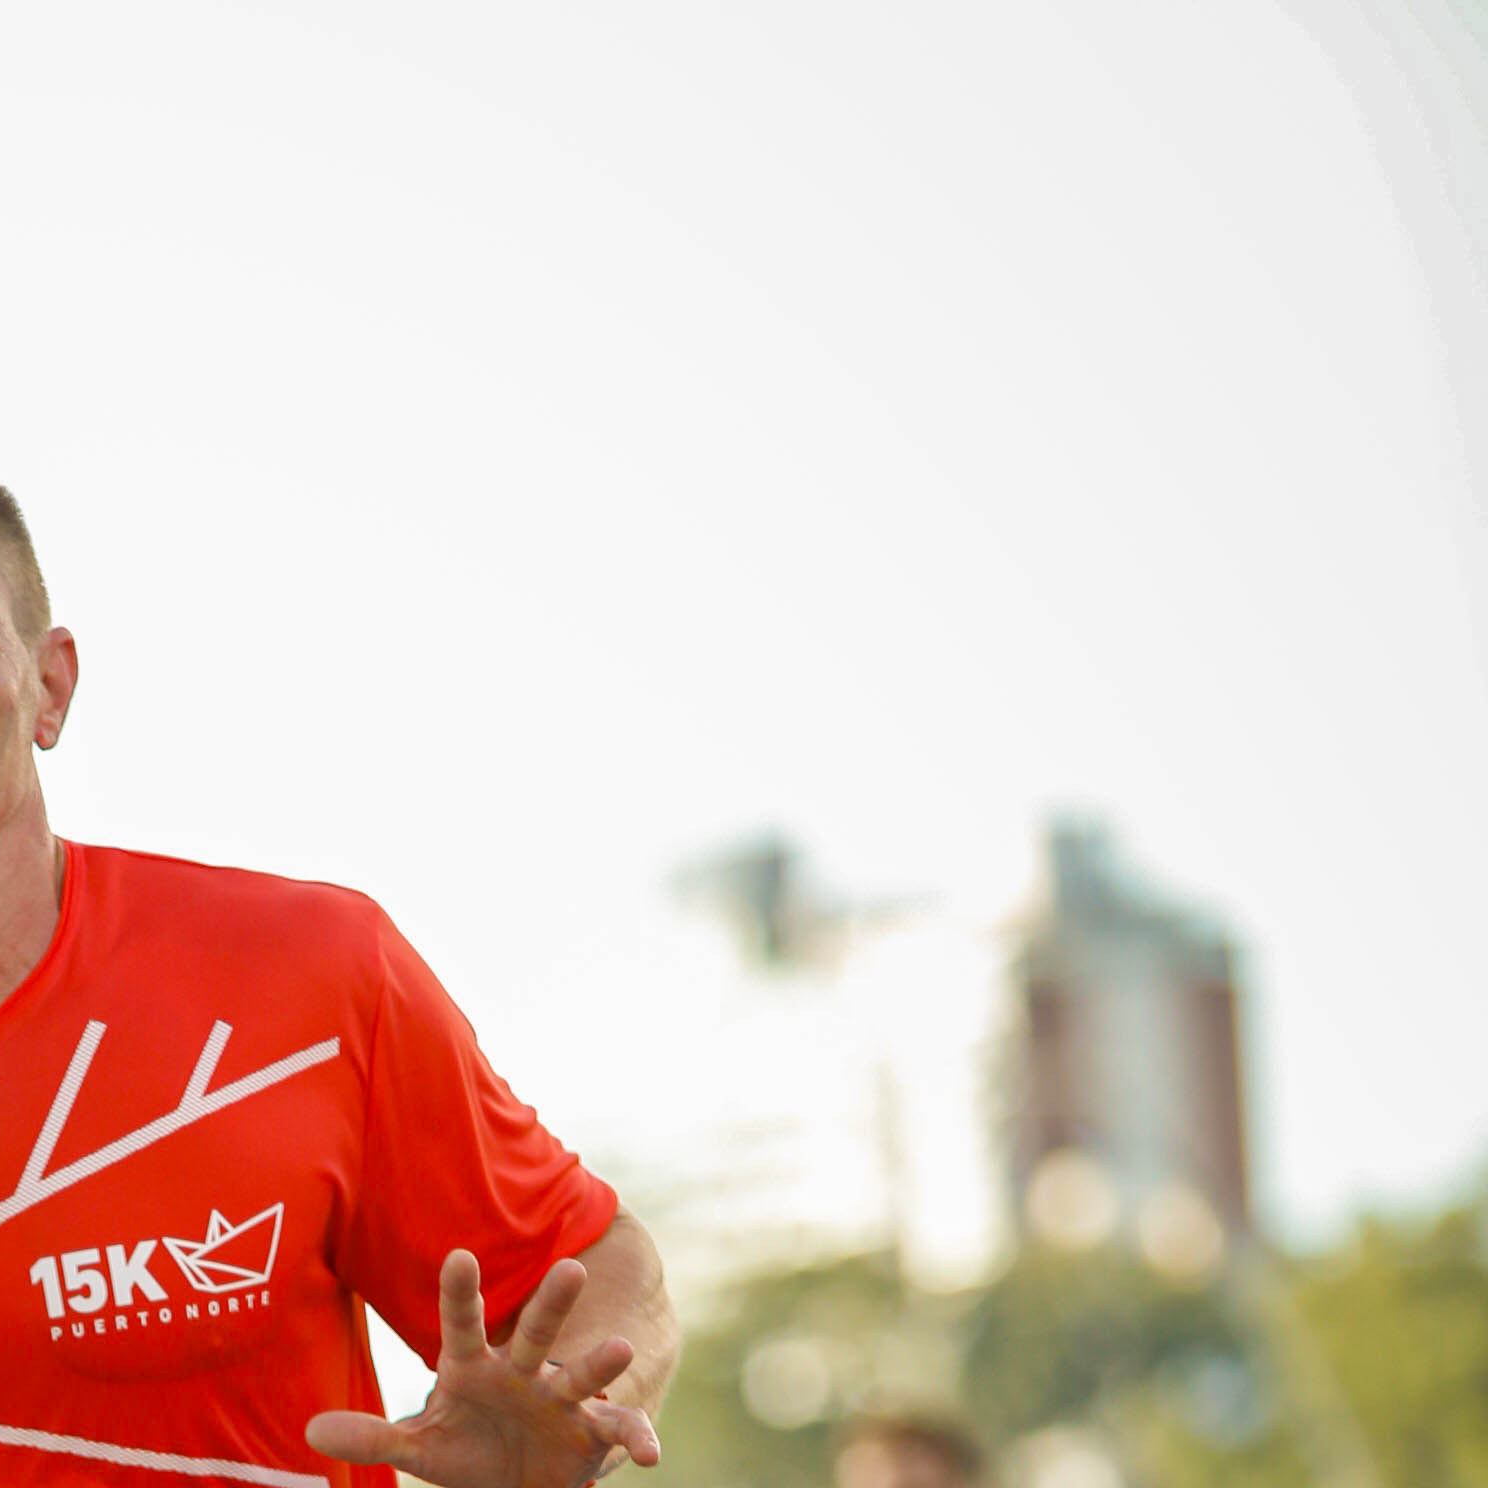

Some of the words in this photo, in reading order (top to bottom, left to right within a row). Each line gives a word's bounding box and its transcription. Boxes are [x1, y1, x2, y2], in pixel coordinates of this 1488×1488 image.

[29, 1239, 169, 1320] 15K
[50, 1308, 172, 1341] PUERTO
[185, 1290, 270, 1320] NORTE
